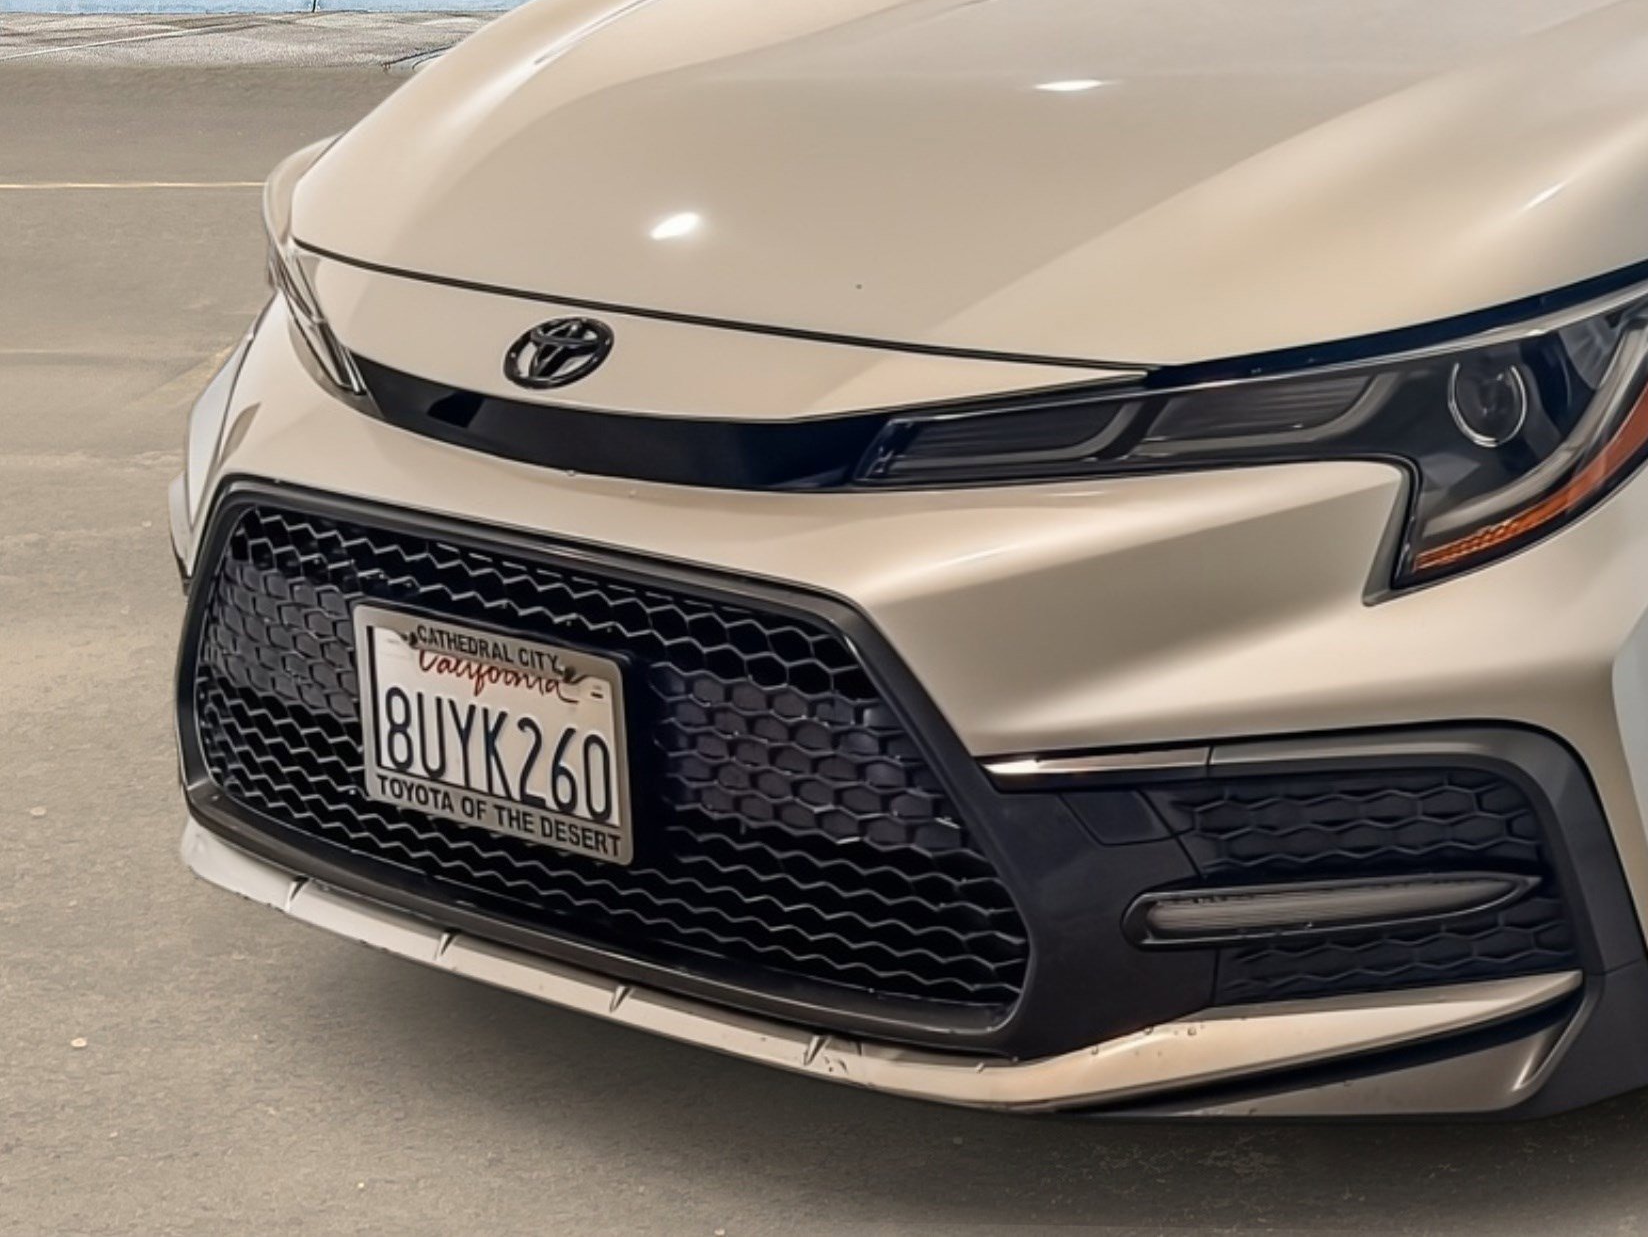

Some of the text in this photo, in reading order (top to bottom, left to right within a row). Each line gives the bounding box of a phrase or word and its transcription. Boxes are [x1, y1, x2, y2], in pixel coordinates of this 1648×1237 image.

[416, 625, 563, 674] CATHEDRAL CITY
[419, 649, 579, 704] California
[385, 687, 611, 821] 8UYK260
[377, 774, 622, 858] TOYOTA OF THE DESERT
